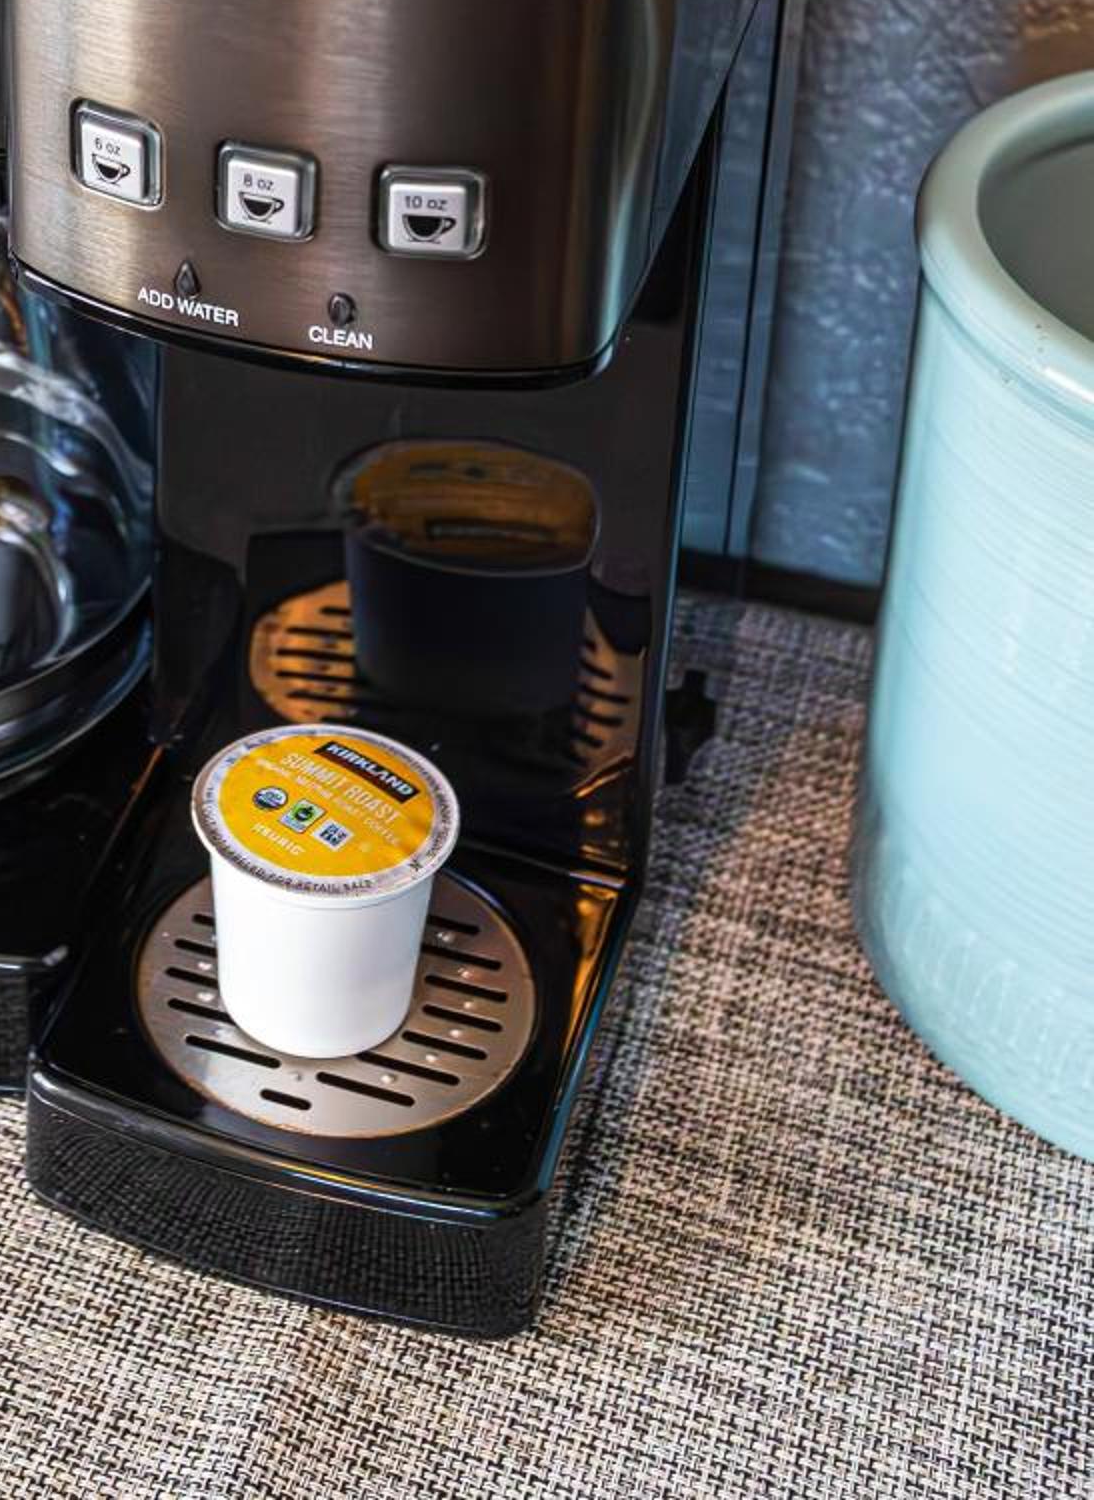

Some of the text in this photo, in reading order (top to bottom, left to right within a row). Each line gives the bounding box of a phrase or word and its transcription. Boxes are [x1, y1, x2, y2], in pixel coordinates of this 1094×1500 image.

[95, 137, 103, 150] 6
[243, 173, 274, 191] 8 oz
[405, 195, 447, 211] 10 oz
[137, 287, 239, 327] ADD WATER
[308, 325, 373, 350] CLEAN
[326, 743, 414, 796] KIRKLAND
[281, 753, 347, 790] SUMMIT
[345, 786, 400, 824] ROAST
